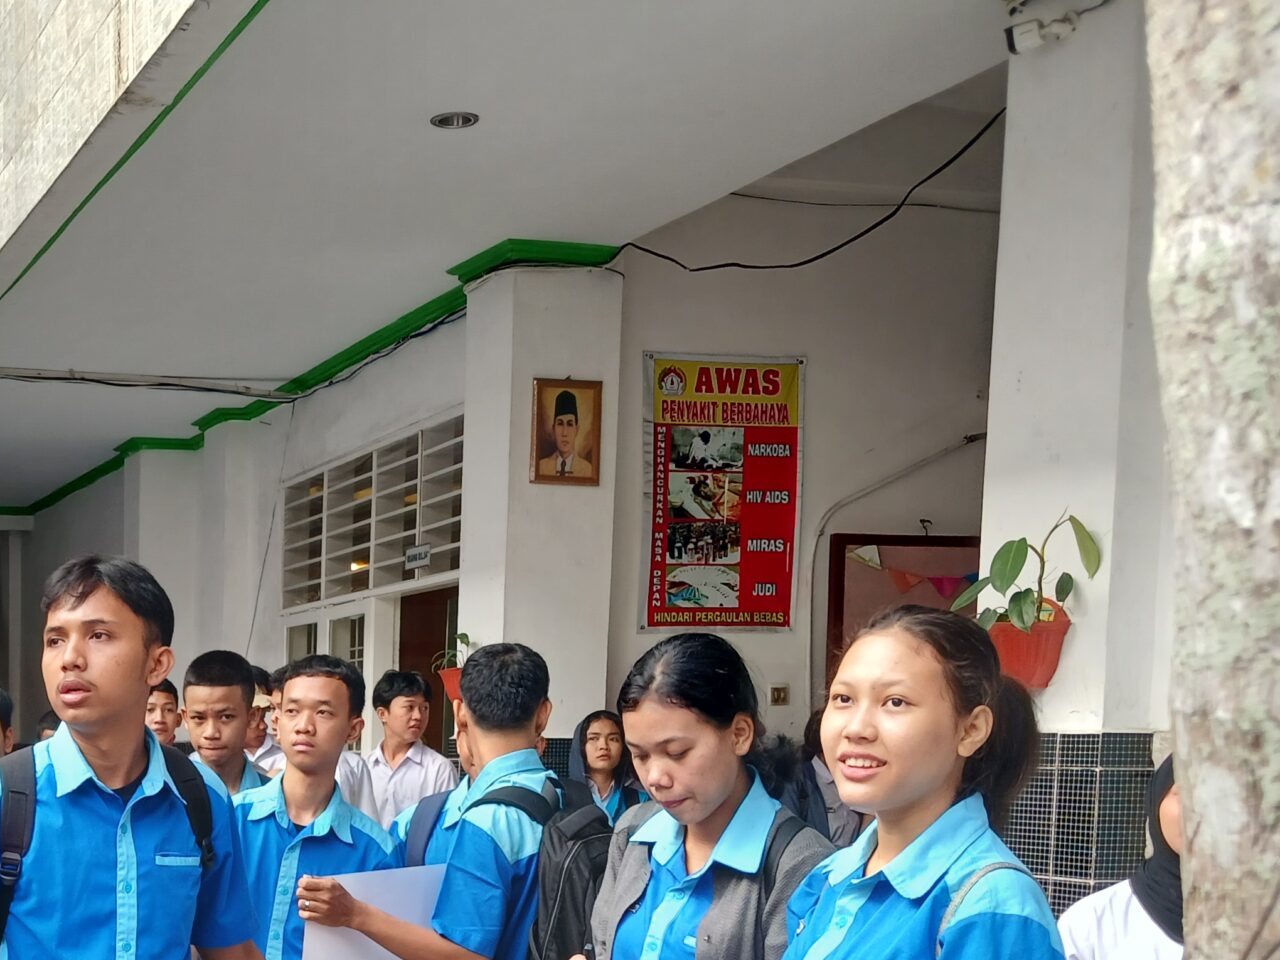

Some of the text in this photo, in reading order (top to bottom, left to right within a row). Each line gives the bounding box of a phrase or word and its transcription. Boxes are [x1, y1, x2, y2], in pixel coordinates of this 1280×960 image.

[694, 366, 781, 396] AWAS
[661, 399, 790, 425] PENYAKIT BERBAHAYA
[747, 443, 790, 457] NARKOBA
[746, 490, 789, 504] HIV AIDS
[652, 426, 666, 607] MENGHANCURKAN MASA DEPAN
[747, 539, 784, 552] MIRAS
[752, 583, 776, 596] JUDI
[654, 611, 693, 623] HINDARI
[695, 611, 751, 623] PERGAULAN
